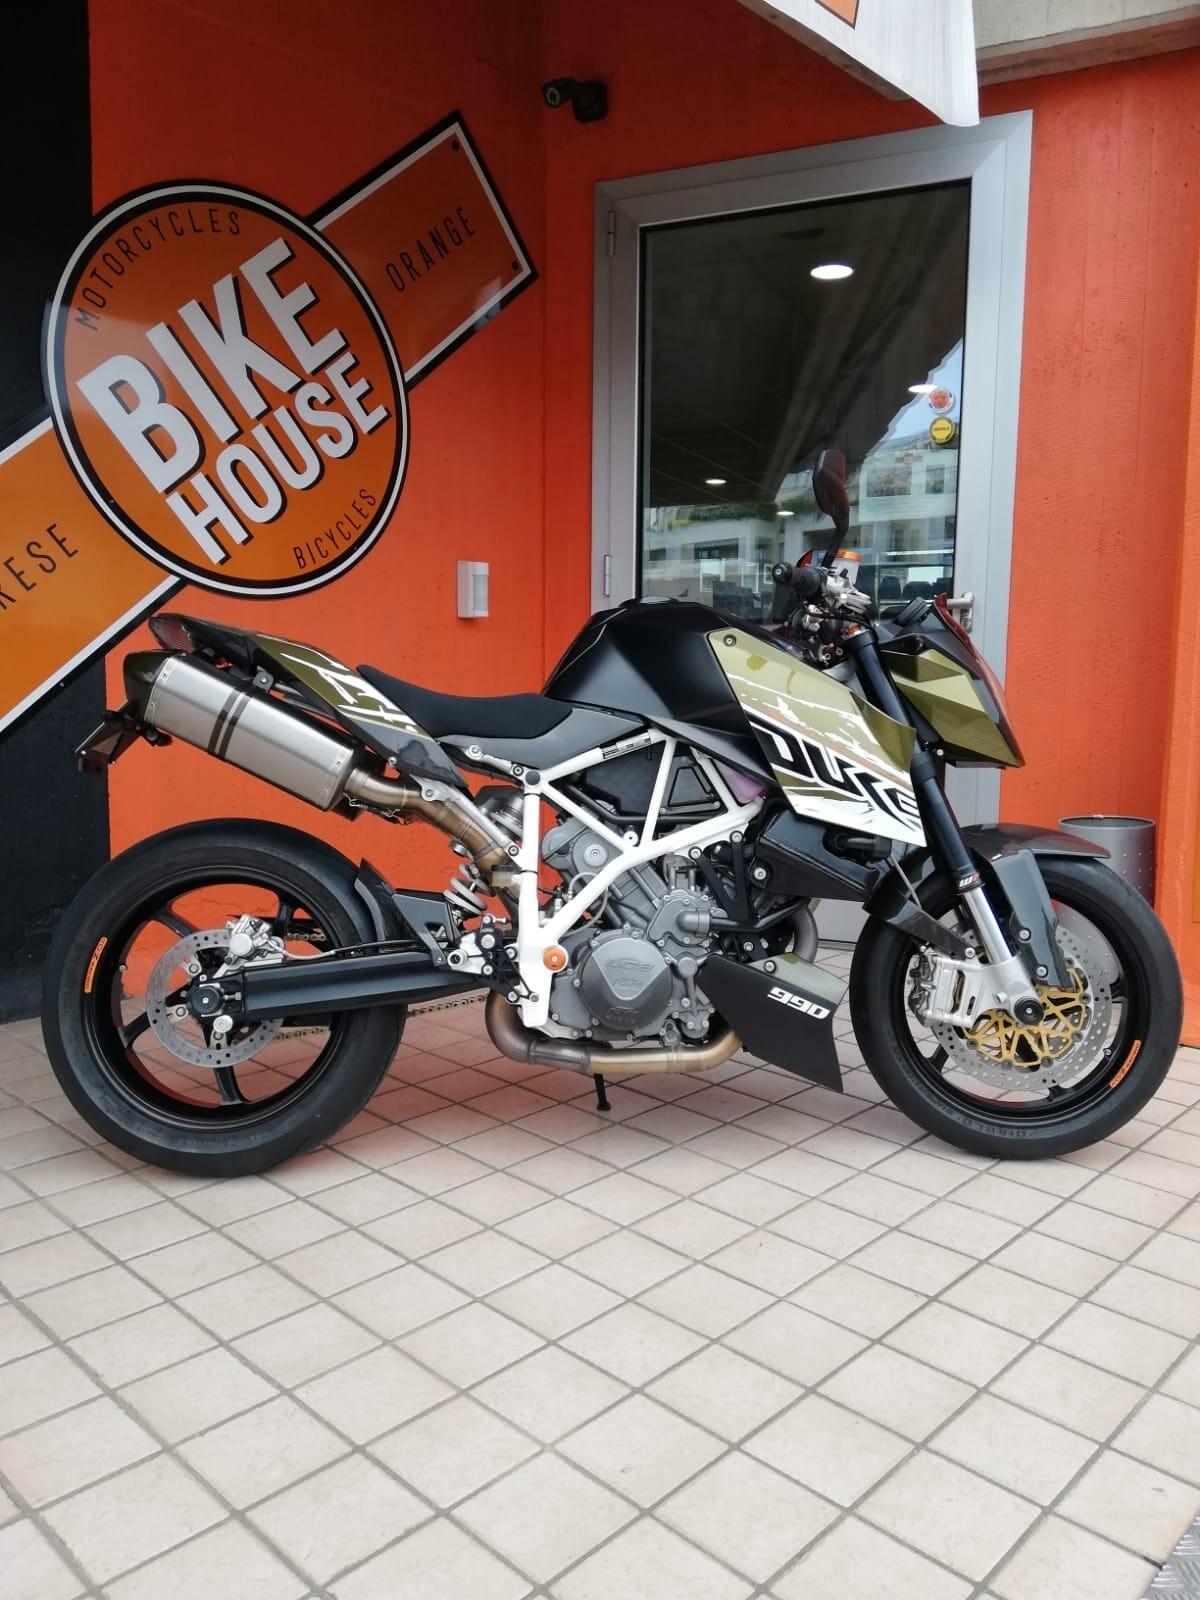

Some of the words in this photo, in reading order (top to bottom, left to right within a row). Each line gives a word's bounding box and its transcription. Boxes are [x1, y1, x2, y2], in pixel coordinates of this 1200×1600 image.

[74, 207, 240, 332] MOTORCYCLES
[386, 206, 475, 292] ORANGE
[76, 237, 348, 494] BIKE
[165, 352, 391, 565] HOUSE
[293, 488, 377, 569] BICYCLES
[743, 712, 922, 832] DUKE
[766, 986, 831, 1020] 990
